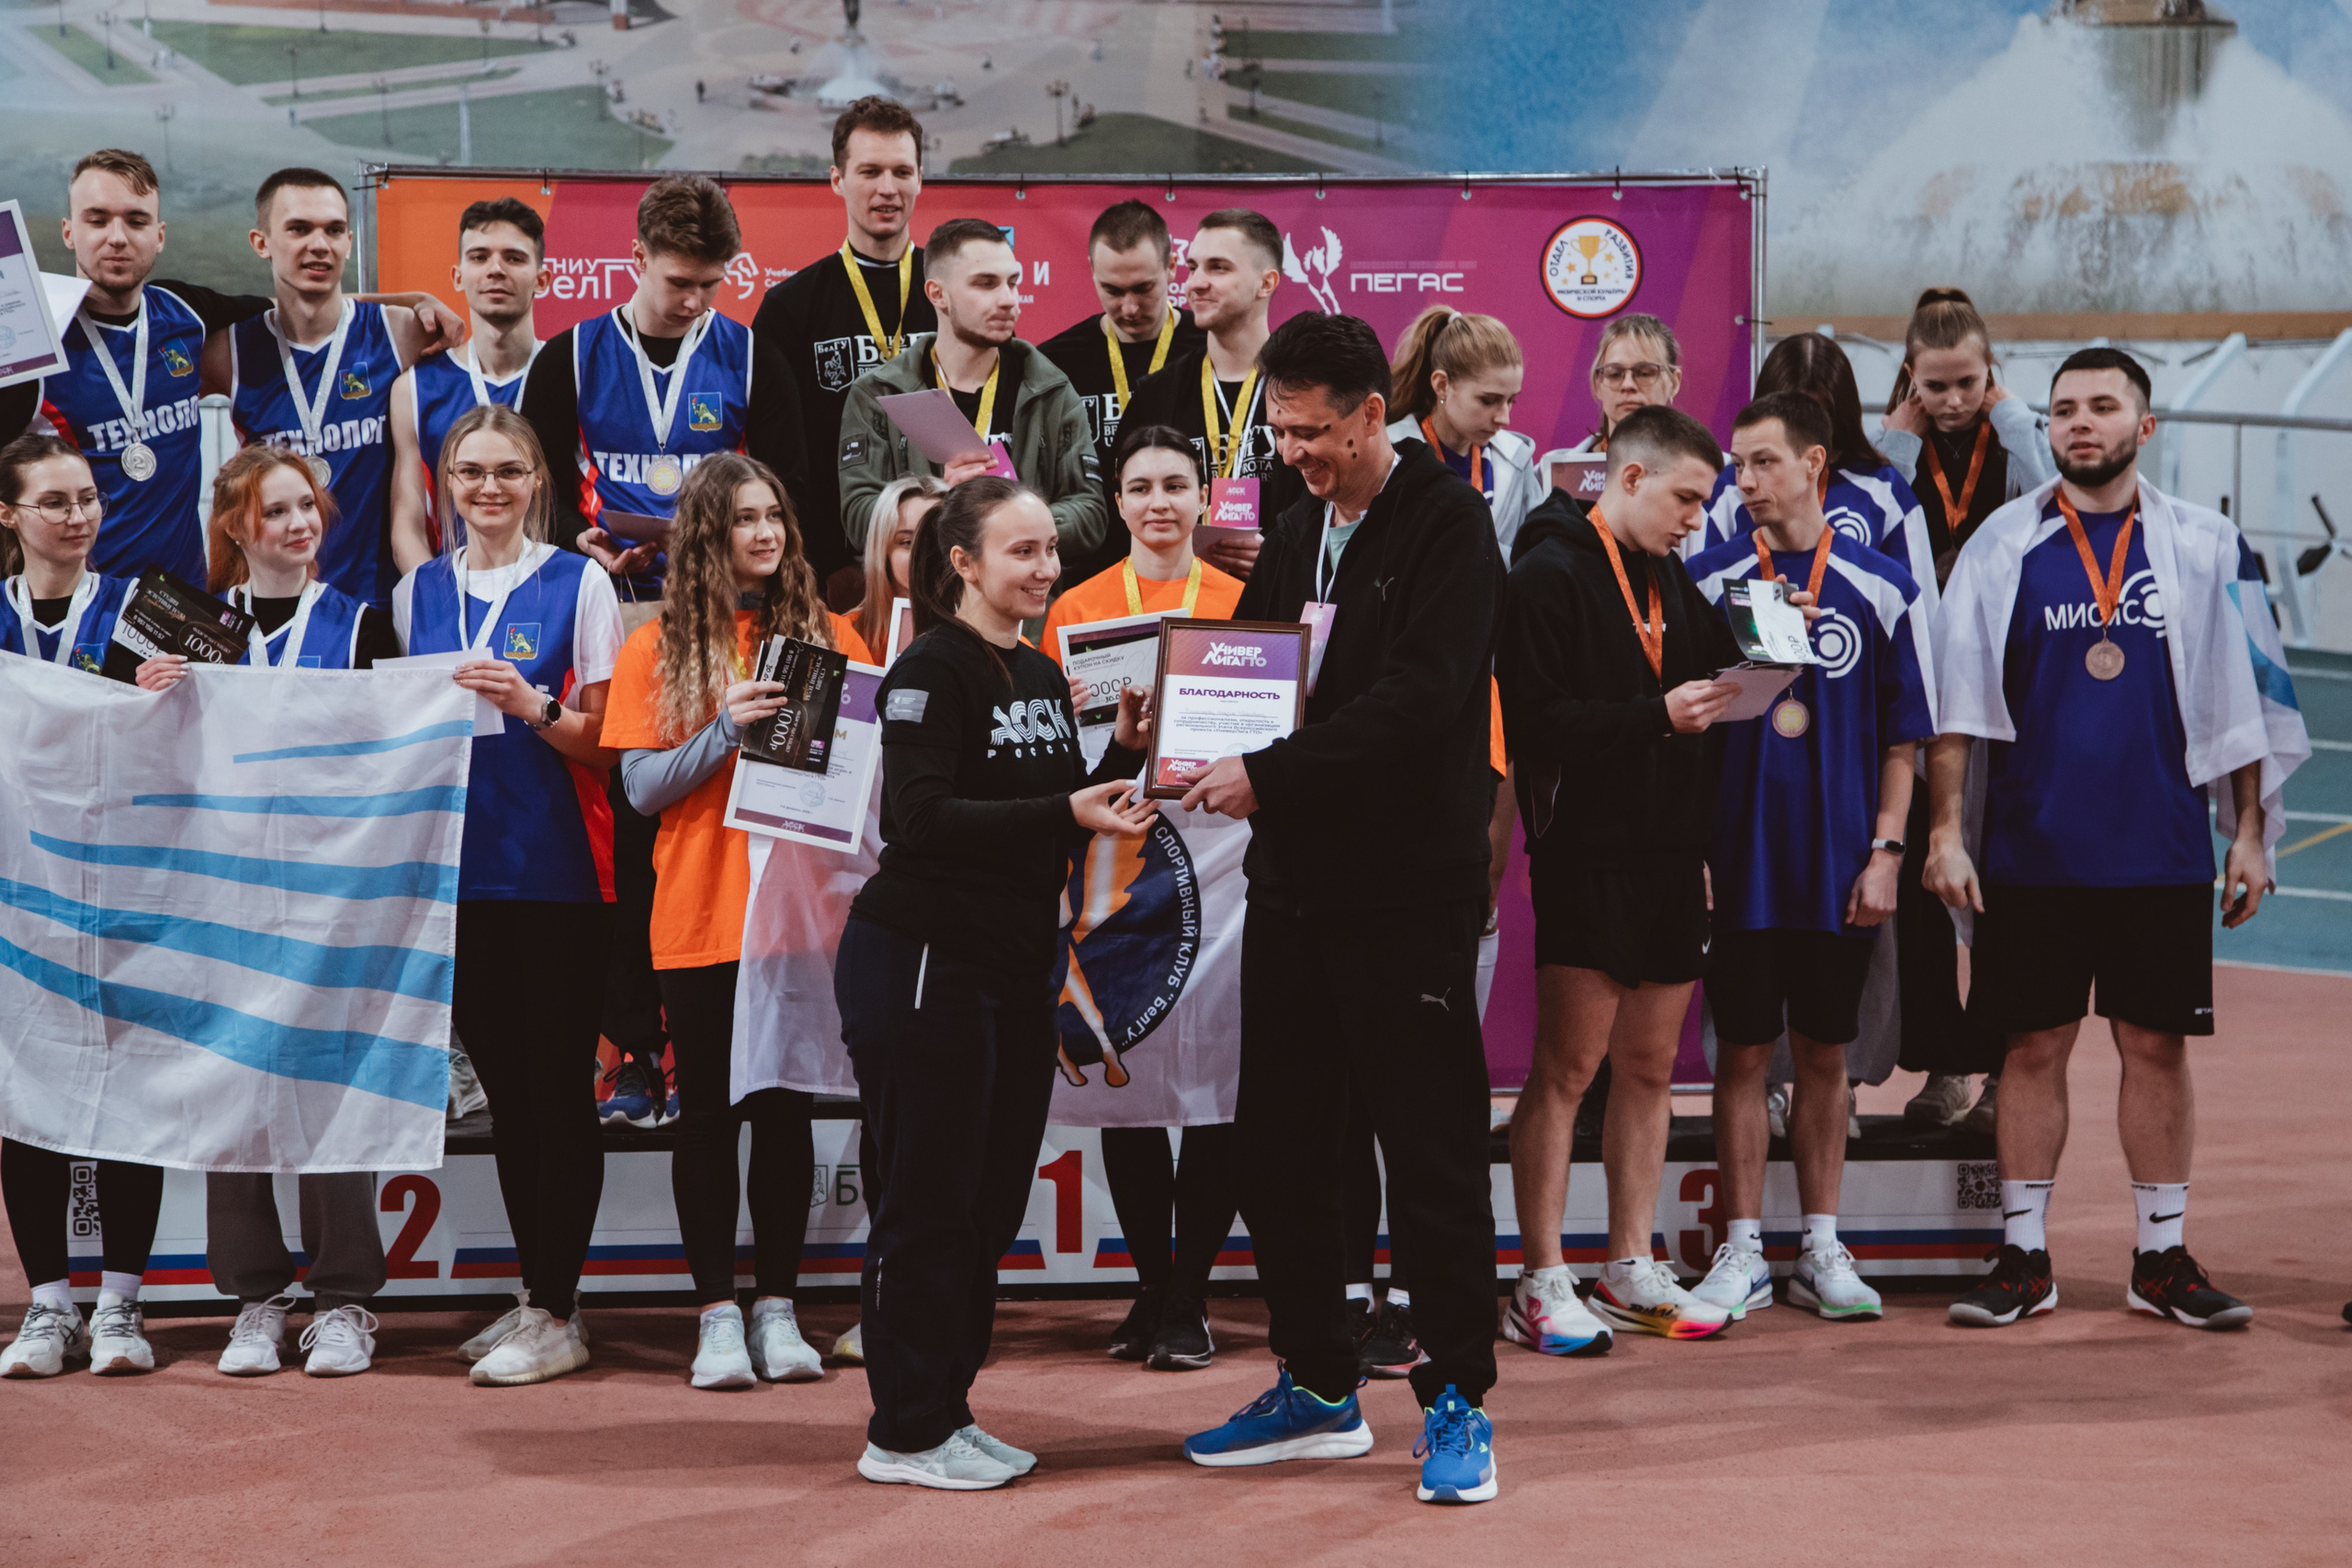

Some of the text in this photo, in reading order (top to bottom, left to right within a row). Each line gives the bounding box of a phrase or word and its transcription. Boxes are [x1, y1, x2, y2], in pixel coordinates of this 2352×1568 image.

[1549, 229, 1634, 279] ОТДЕЛ РАЗВИТИЯ
[1351, 273, 1464, 292] ПЕГАС
[86, 394, 199, 452] ТЕХНОЛО
[261, 414, 386, 457] ТЕХНОЛОГ
[1071, 652, 1111, 665] ПОДАРОЧНЫЙ
[1102, 655, 1125, 664] СКИДКУ
[1179, 688, 1281, 700] БЛАГОДАРНОСТЬ
[1155, 826, 1198, 938] СПОРТИВНЫЙ
[1167, 942, 1193, 987] КЛУБ
[1038, 1150, 1082, 1253] 1
[1679, 1168, 1729, 1272] 3
[379, 1175, 442, 1279] 2
